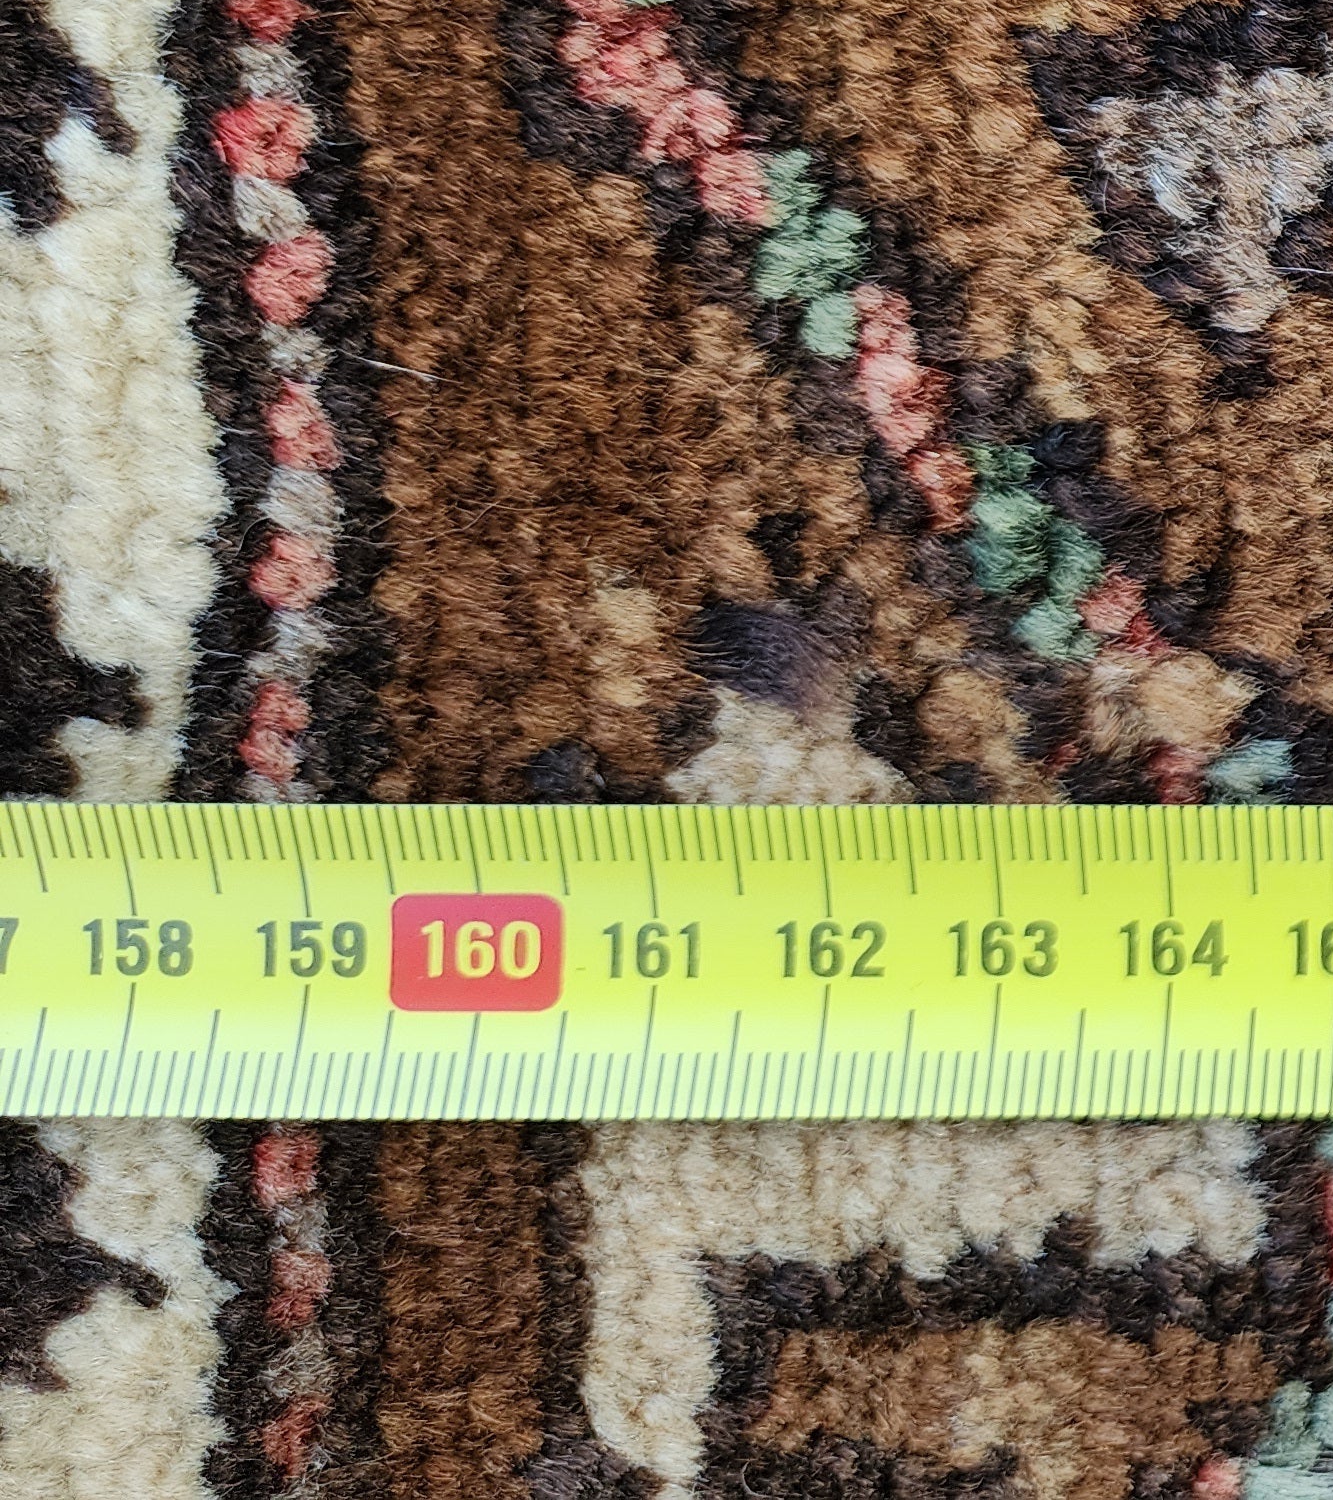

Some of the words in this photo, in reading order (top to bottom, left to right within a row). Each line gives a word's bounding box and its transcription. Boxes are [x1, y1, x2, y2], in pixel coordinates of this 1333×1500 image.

[83, 919, 193, 977] 158
[256, 921, 367, 978] 159
[421, 920, 540, 979] 160
[603, 923, 699, 978] 161
[776, 922, 885, 978] 162
[949, 921, 1057, 977] 163
[1120, 921, 1229, 977] 164
